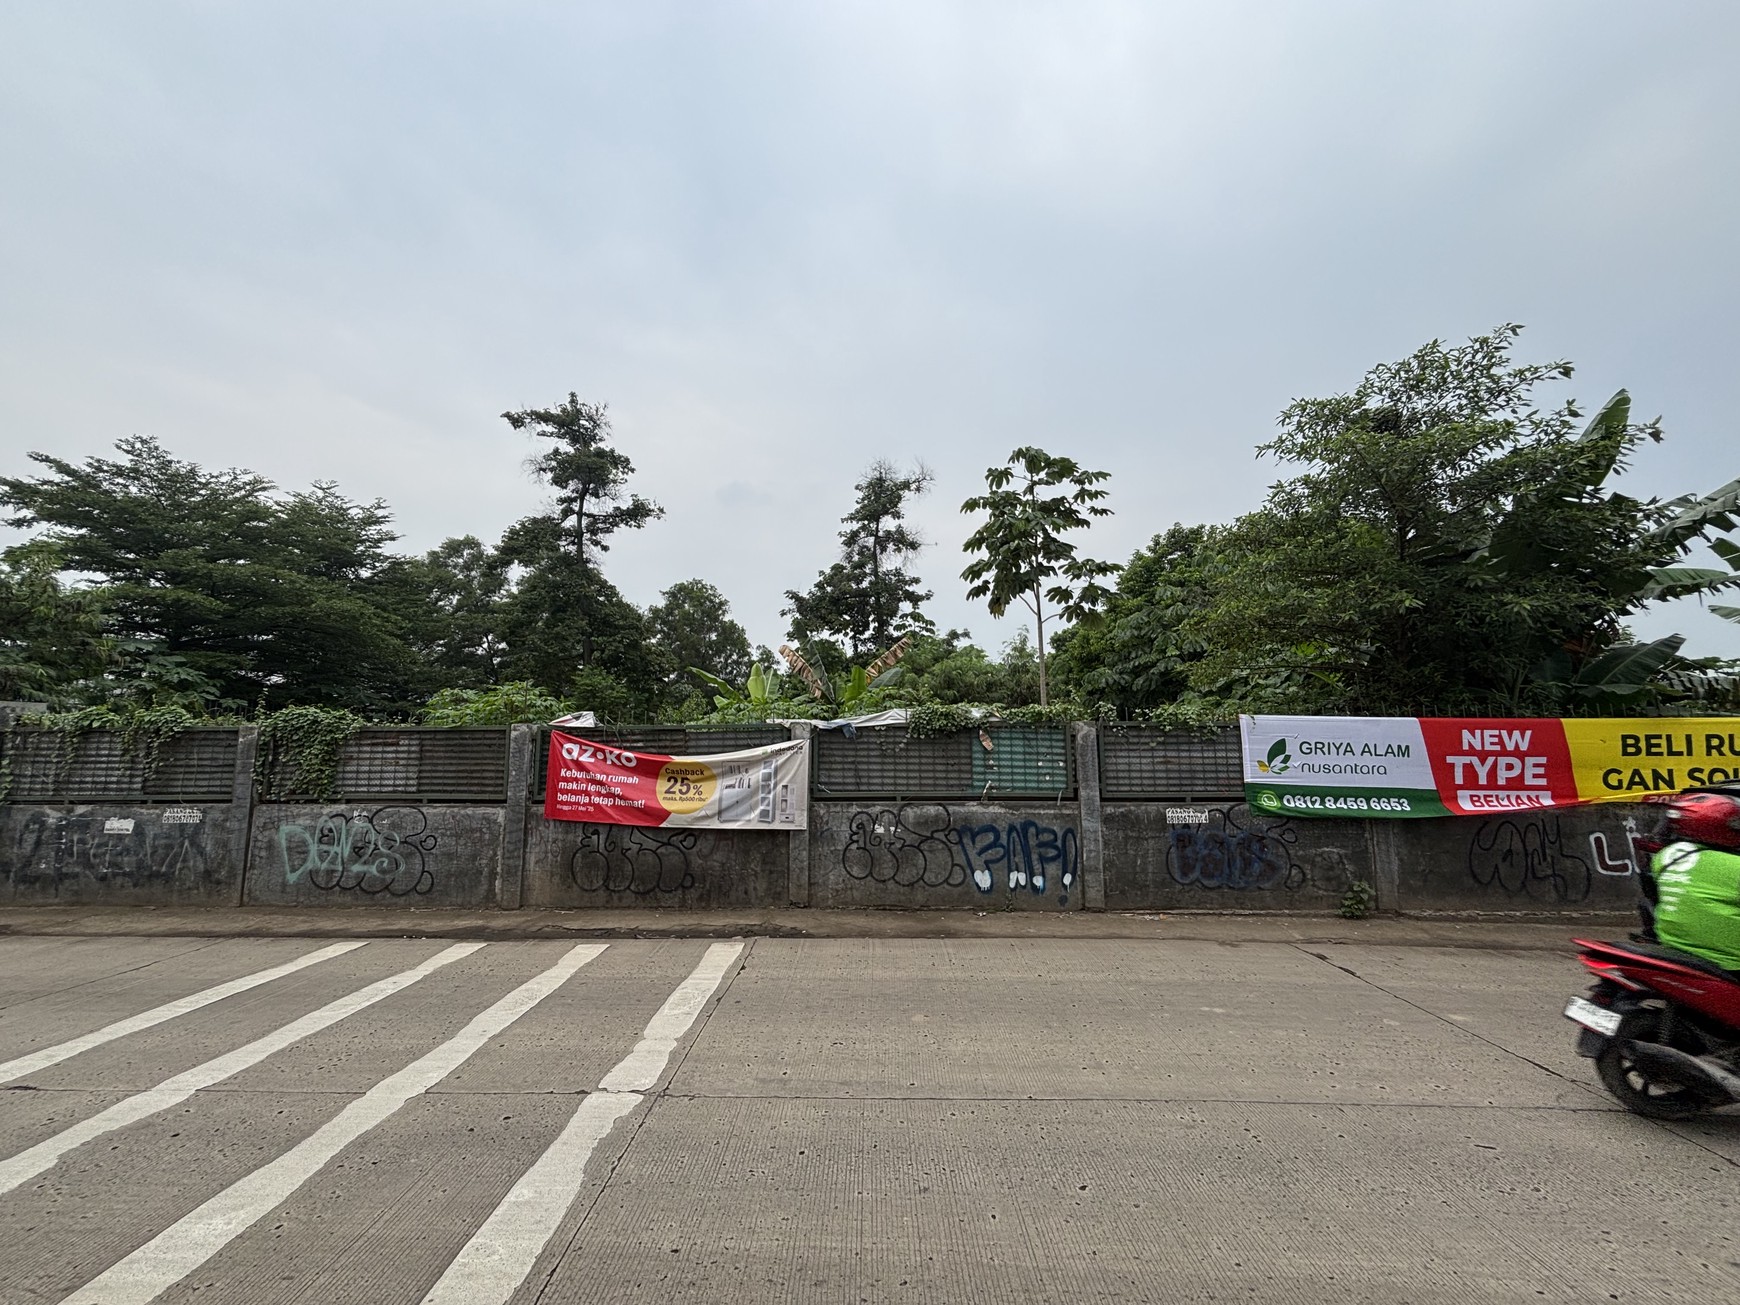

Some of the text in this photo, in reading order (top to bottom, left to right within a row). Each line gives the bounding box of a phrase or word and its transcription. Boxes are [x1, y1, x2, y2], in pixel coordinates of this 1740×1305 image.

[1462, 729, 1532, 751] NEW
[1621, 734, 1694, 756] BELI
[1299, 741, 1411, 758] GRIYA ALAM
[560, 768, 639, 784] Kebutuhan rumah
[664, 767, 705, 776] Cashback
[1301, 762, 1387, 775] nusantara
[1446, 755, 1547, 785] TYPE
[1602, 767, 1676, 791] GAN
[558, 781, 623, 795] makin lengkap,
[557, 792, 645, 808] belanja tetap hemat!
[1283, 794, 1411, 811] 0812 8459 6653
[1469, 794, 1546, 807] BELIAN
